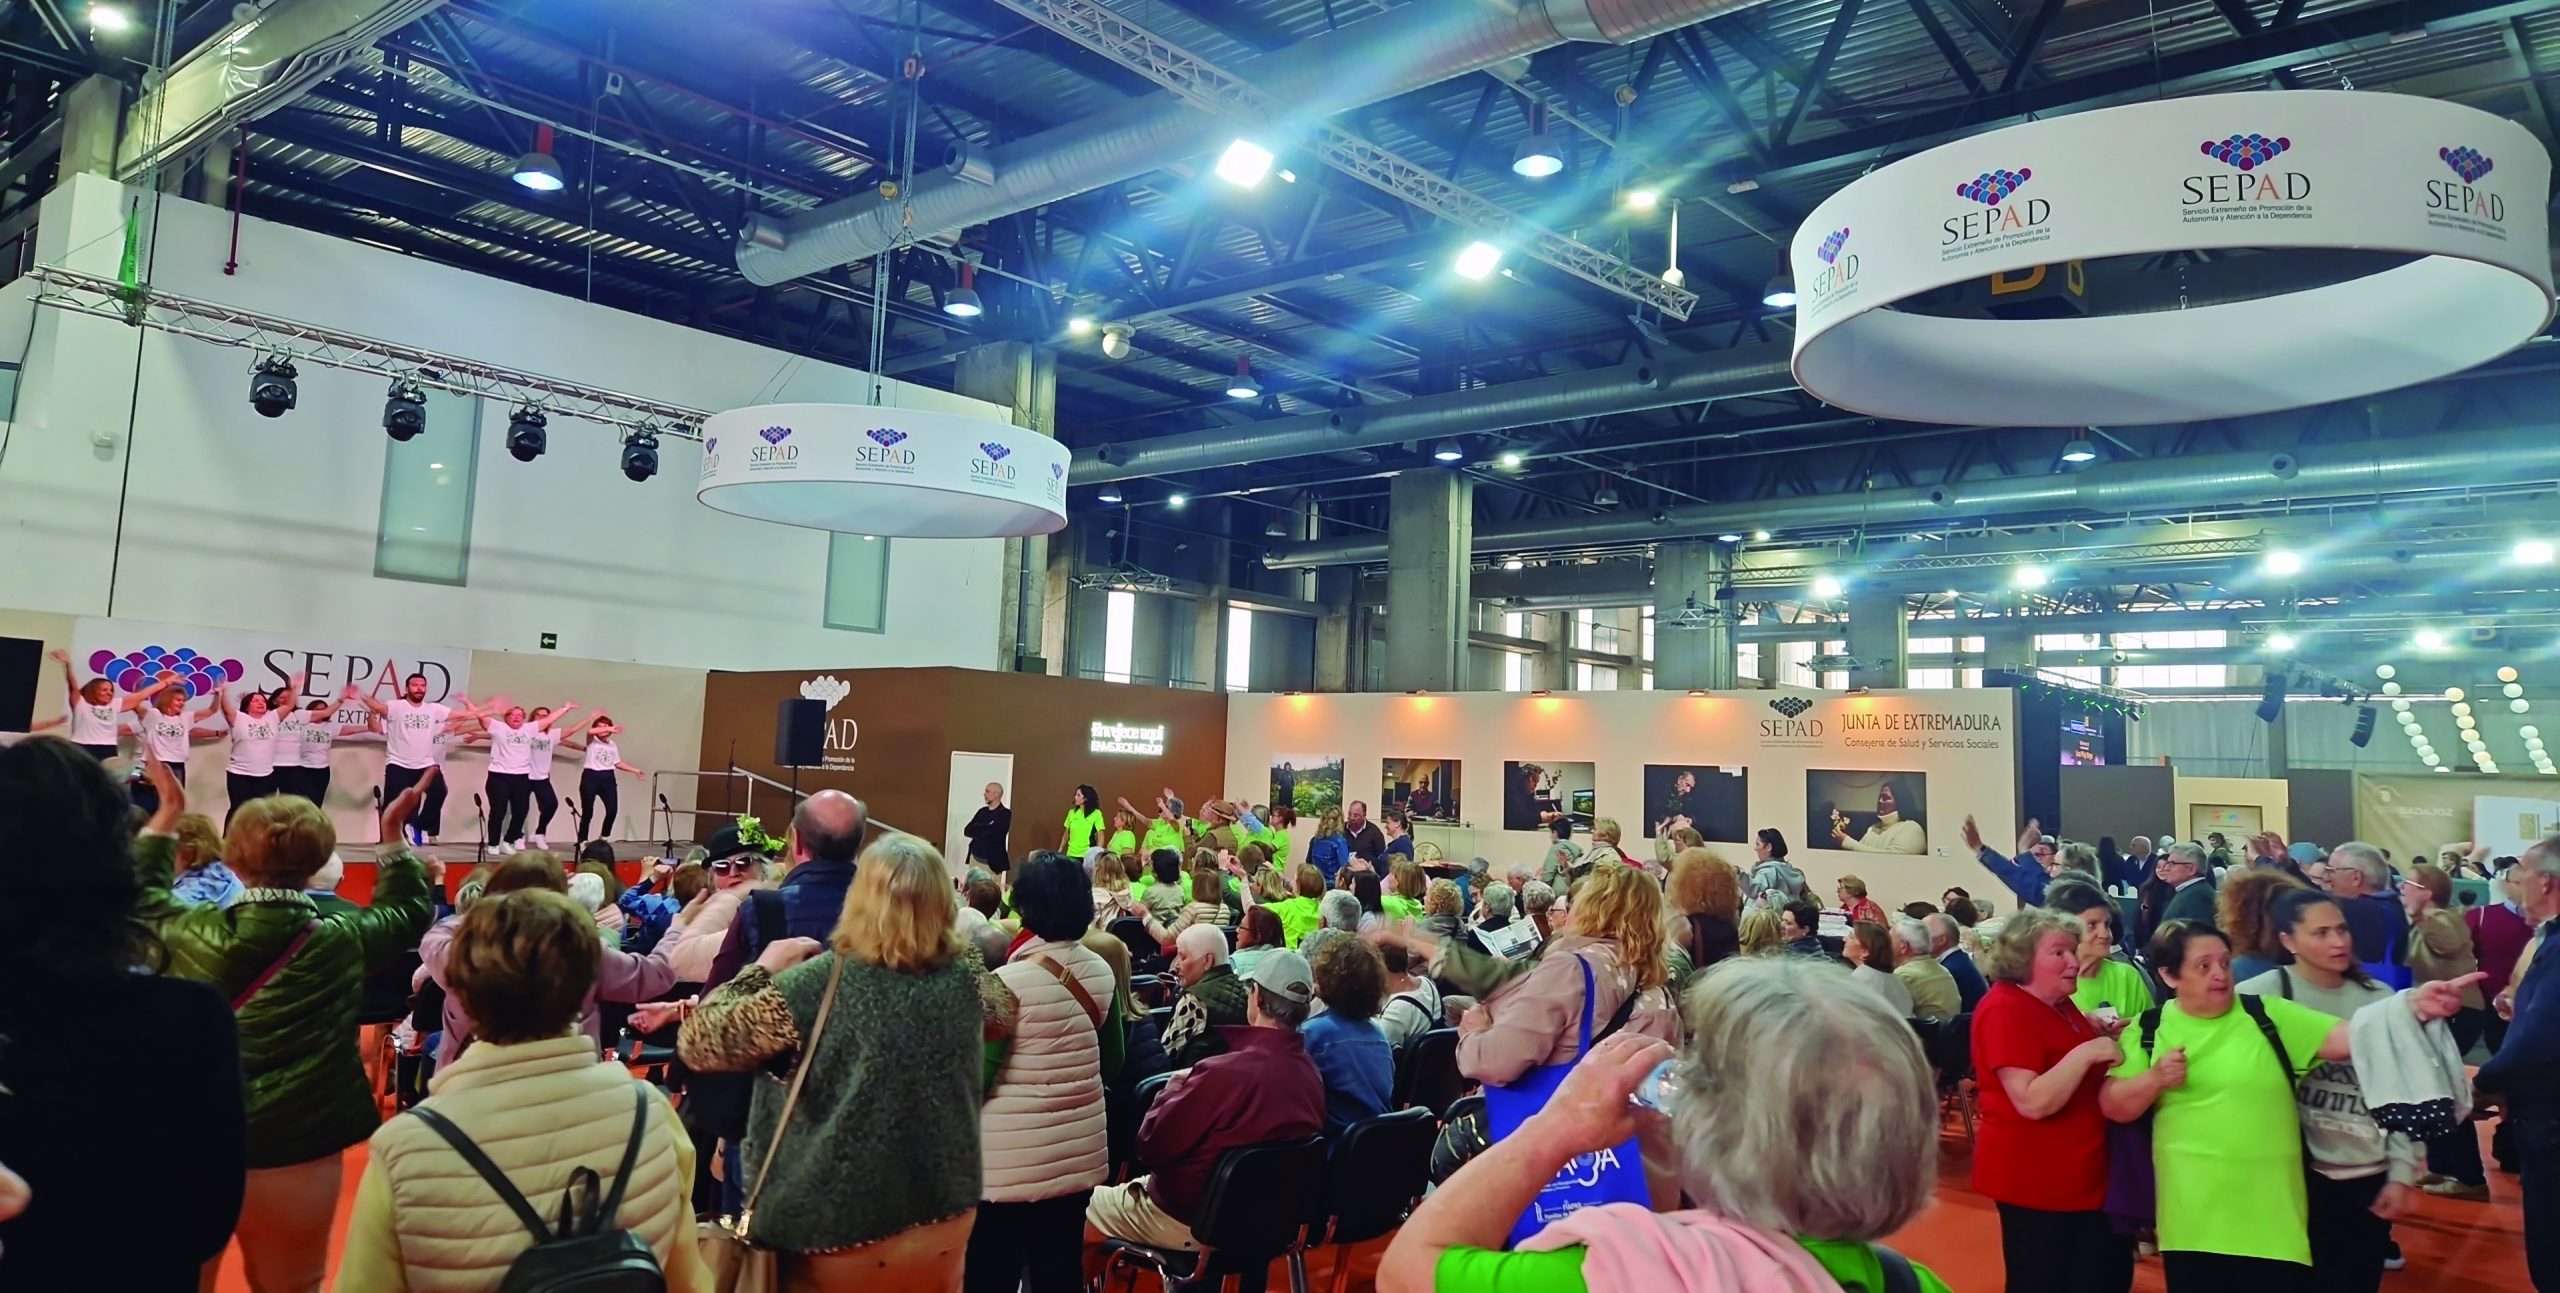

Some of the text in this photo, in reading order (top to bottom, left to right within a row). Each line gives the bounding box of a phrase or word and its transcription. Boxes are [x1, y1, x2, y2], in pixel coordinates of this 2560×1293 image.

[2181, 172, 2311, 205] SEPAD
[2425, 179, 2505, 222] SEPAD
[1941, 198, 2051, 246] SEPAD
[1812, 253, 1859, 303] SEPAD
[750, 445, 799, 462] SEPAD
[855, 446, 915, 464] SEPAD
[970, 458, 1016, 480] SEPAD
[258, 648, 451, 704] SEPAD
[1760, 719, 1824, 737] SEPAD
[1841, 713, 2001, 733] JUNTA DE EXTREMADURA
[1887, 738, 1897, 747] de
[1899, 737, 1920, 748] Salud
[1928, 737, 1965, 749] Servicios
[1967, 738, 2000, 749] Sociales
